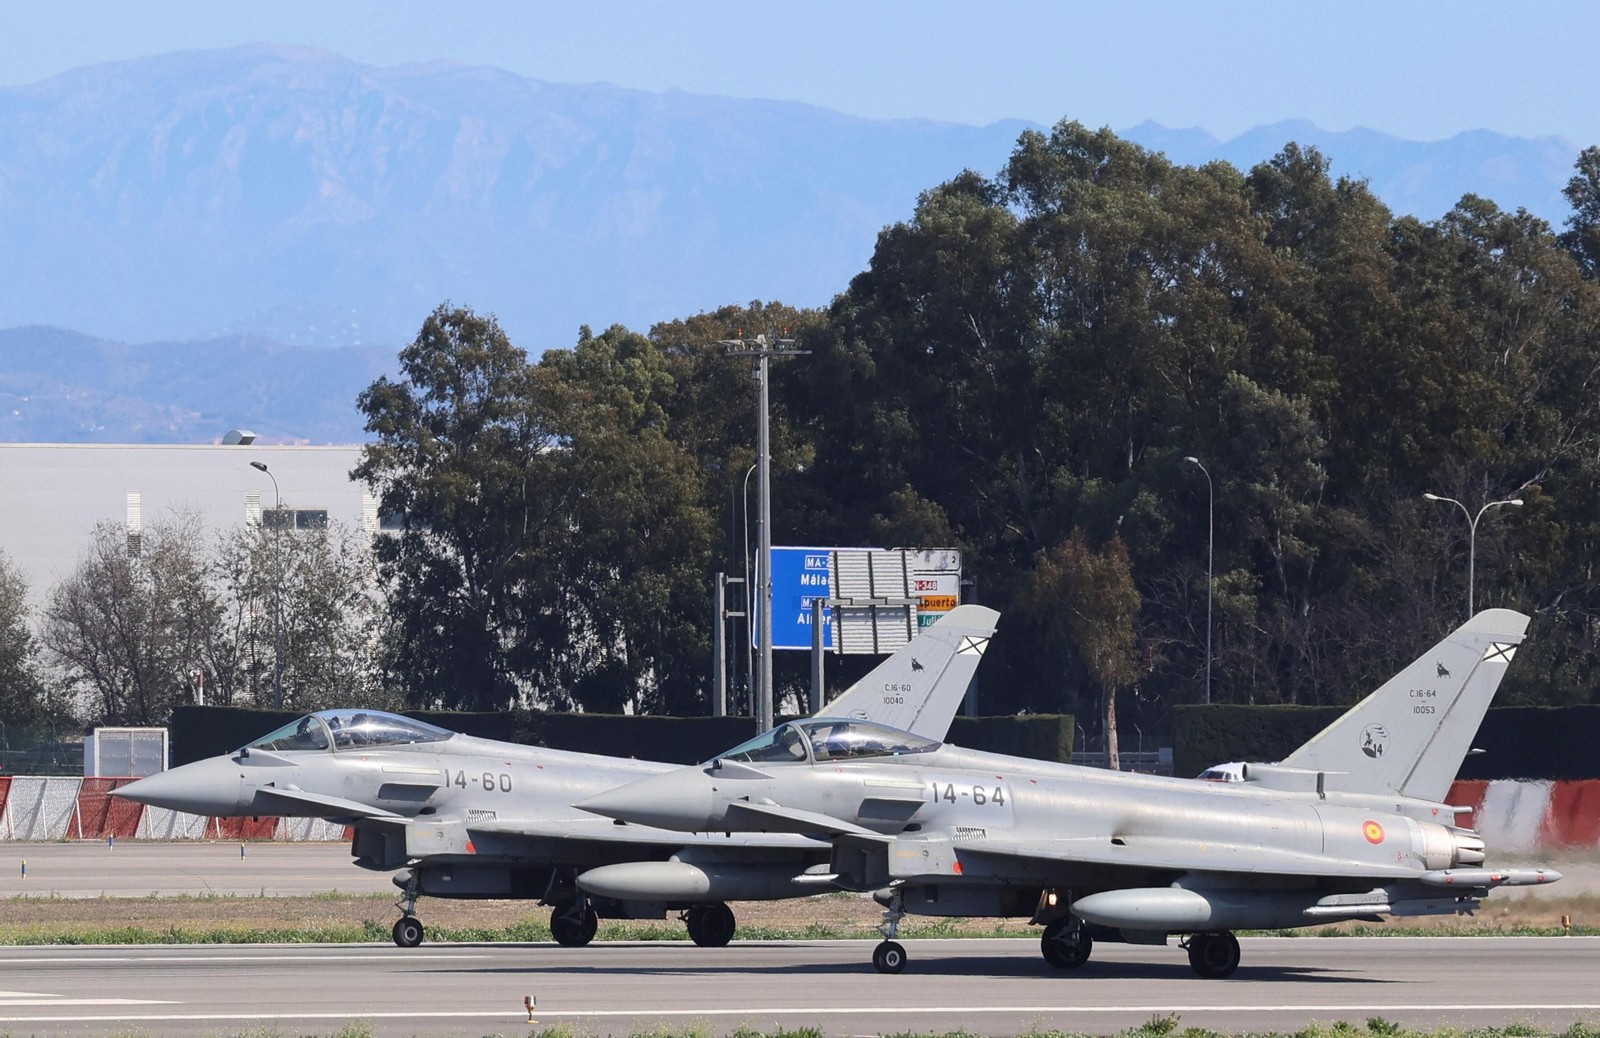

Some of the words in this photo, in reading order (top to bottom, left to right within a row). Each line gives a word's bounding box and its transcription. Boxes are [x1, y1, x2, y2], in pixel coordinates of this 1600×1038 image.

[951, 555, 957, 564] 2
[801, 573, 830, 586] Mála
[1409, 689, 1437, 698] C.16-64
[883, 697, 904, 705] 10040
[1413, 705, 1436, 714] 10053
[1373, 743, 1383, 757] 14
[444, 768, 512, 793] 14-60
[932, 782, 1005, 807] 14-64
